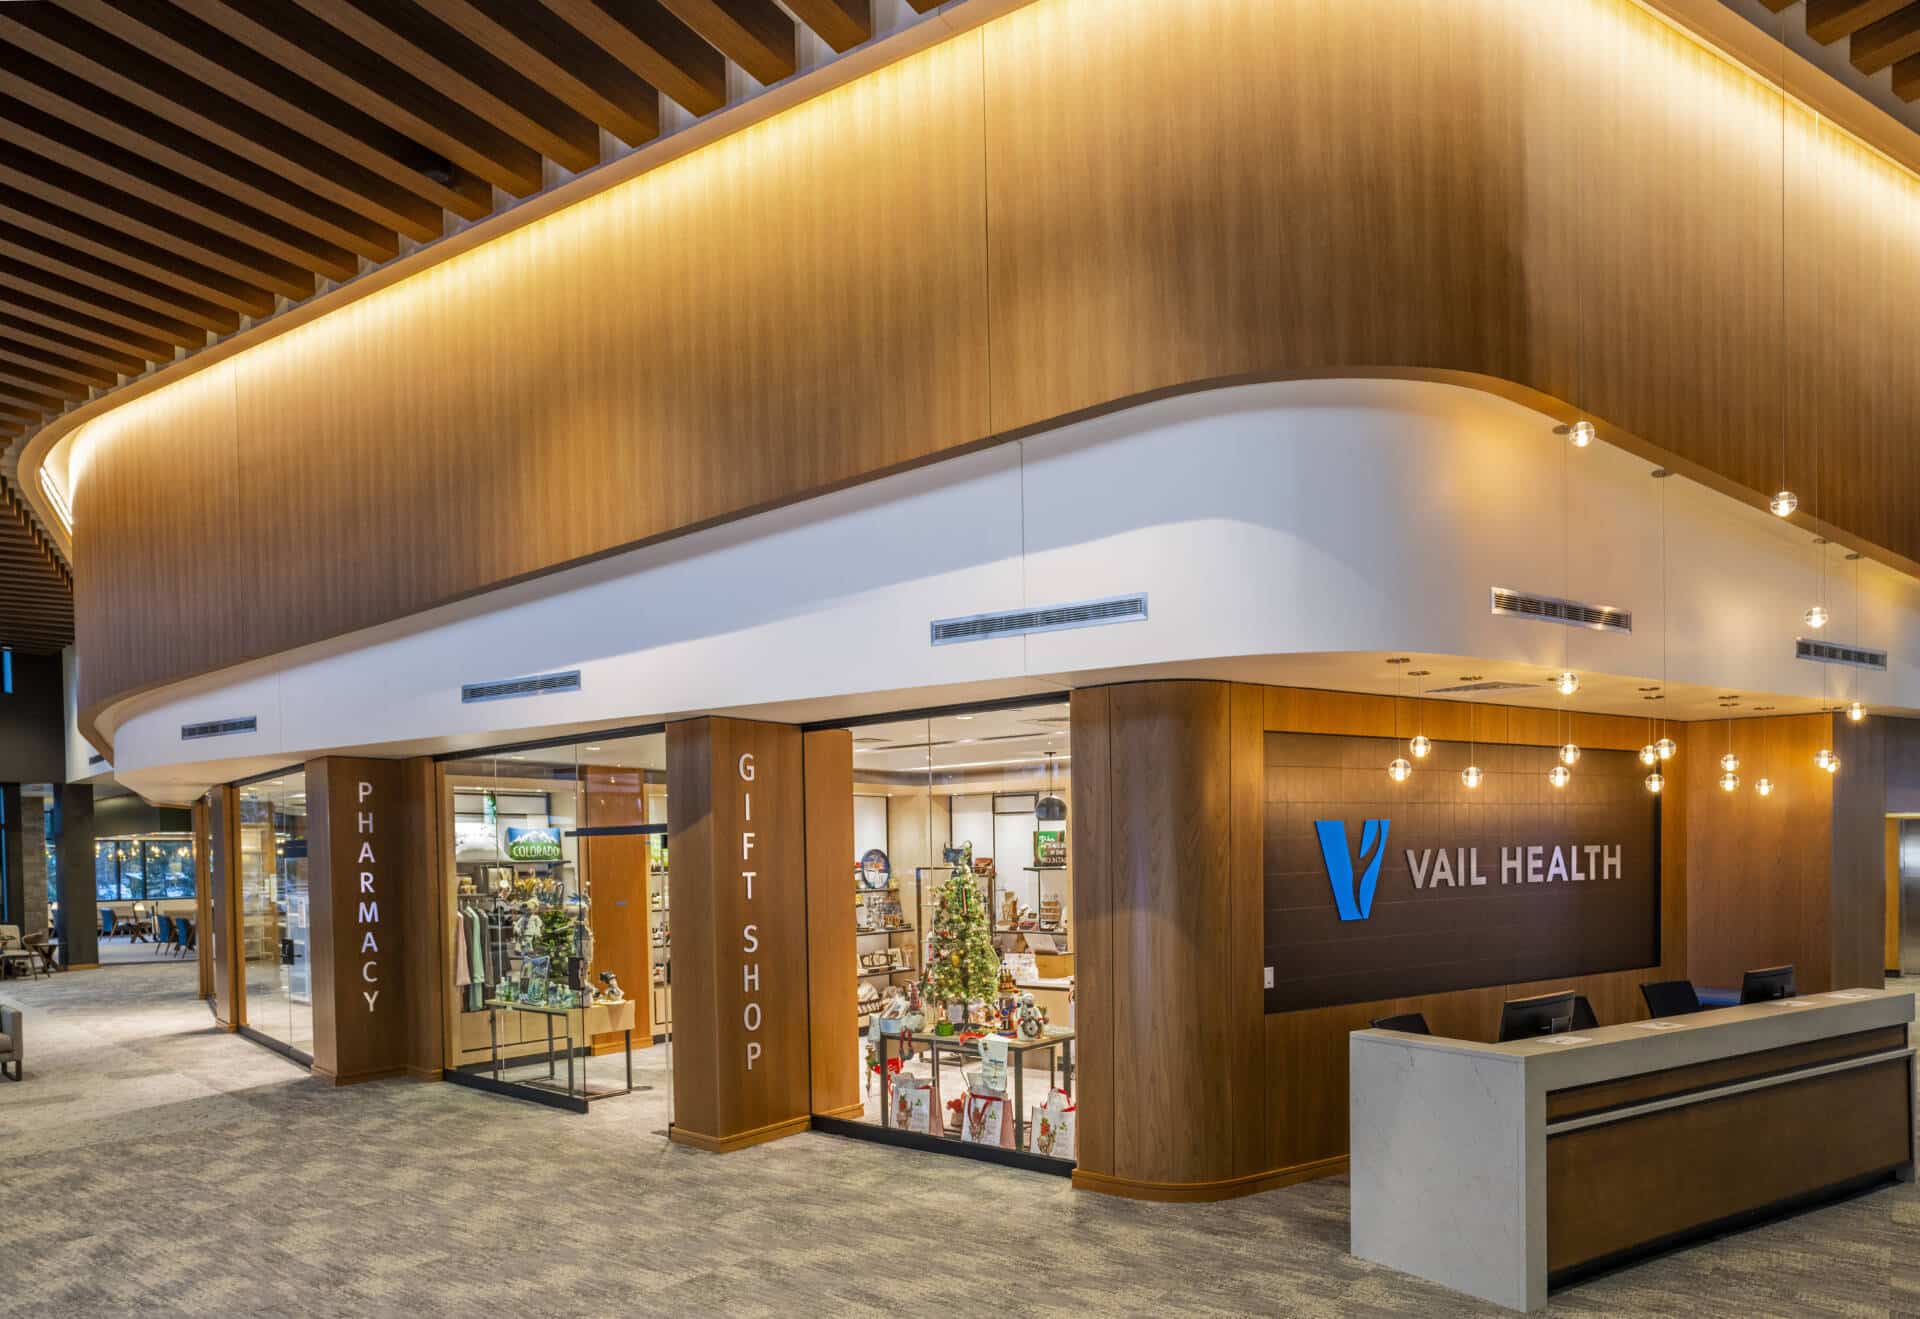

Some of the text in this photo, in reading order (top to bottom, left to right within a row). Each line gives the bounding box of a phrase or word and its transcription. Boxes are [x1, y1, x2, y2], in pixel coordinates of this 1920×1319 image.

[358, 782, 379, 1012] PHARMACY
[513, 846, 560, 857] COLORADO
[738, 753, 762, 1071] GIFT SHOP
[1406, 845, 1622, 889] VAIL HEALTH
